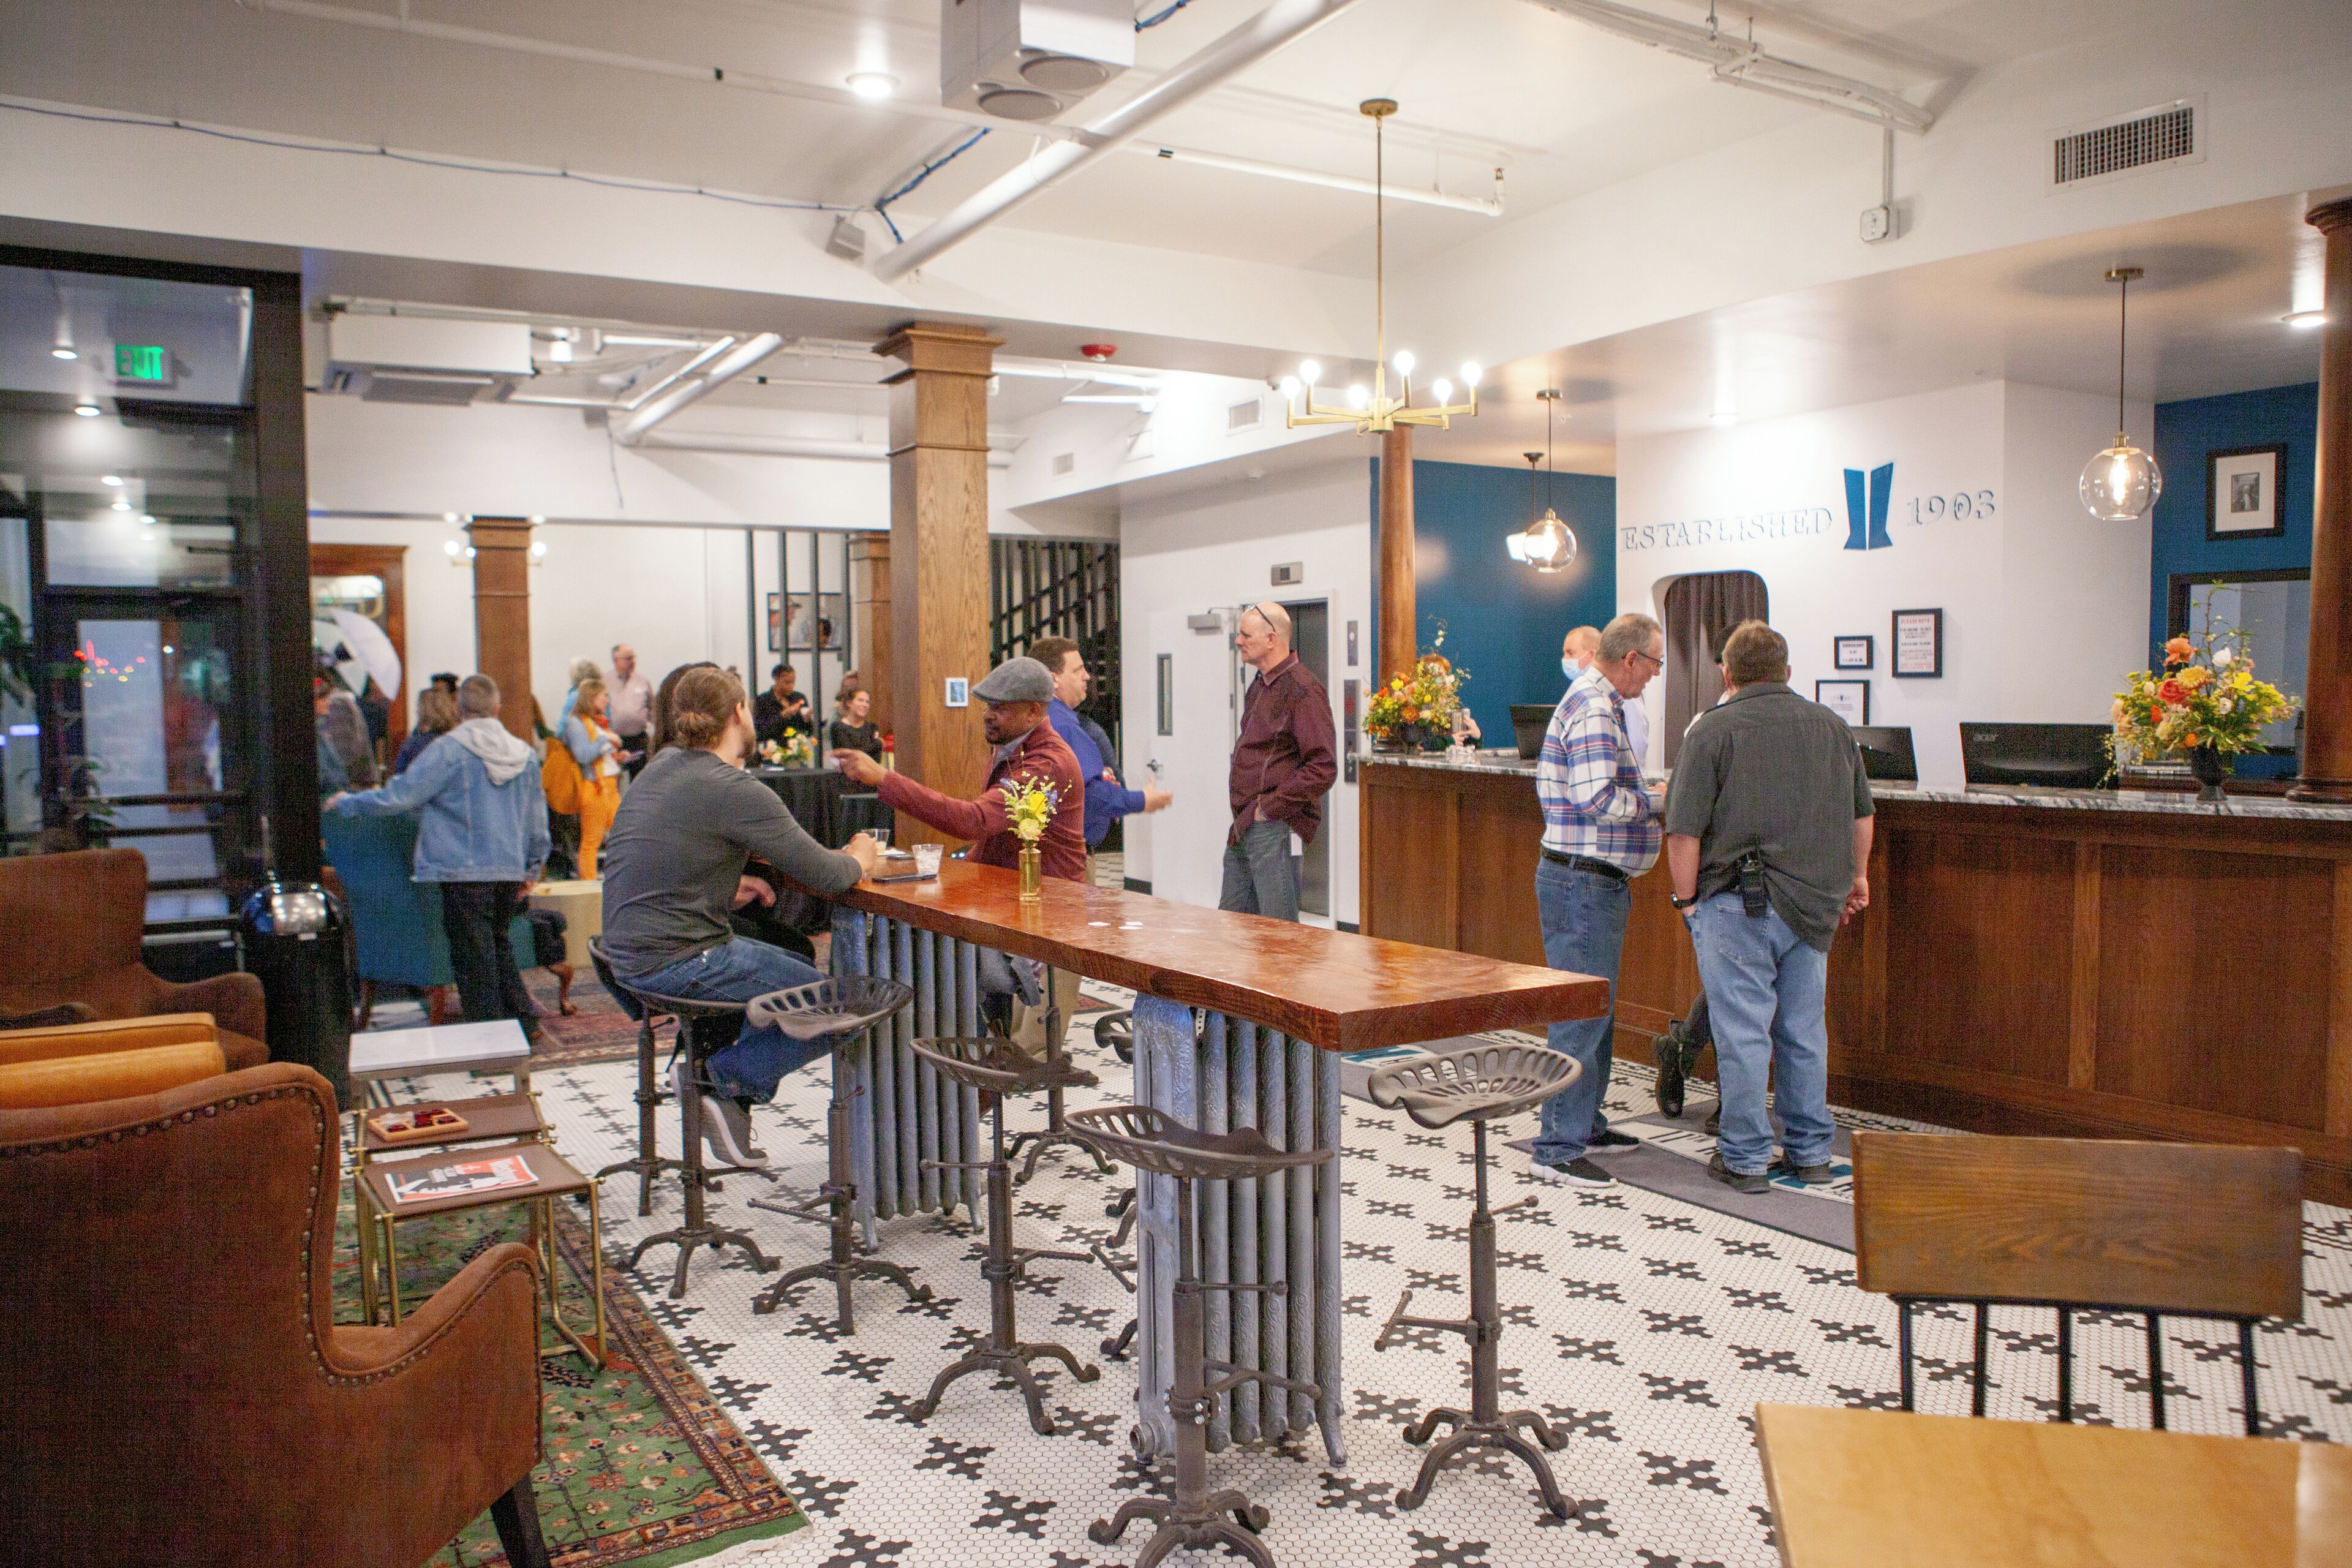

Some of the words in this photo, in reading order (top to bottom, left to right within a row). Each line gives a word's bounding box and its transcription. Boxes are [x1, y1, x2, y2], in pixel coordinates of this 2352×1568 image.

[1619, 507, 1833, 551] ESTABLISHED
[1906, 490, 1996, 526] 1903
[1972, 733, 1999, 742] acer
